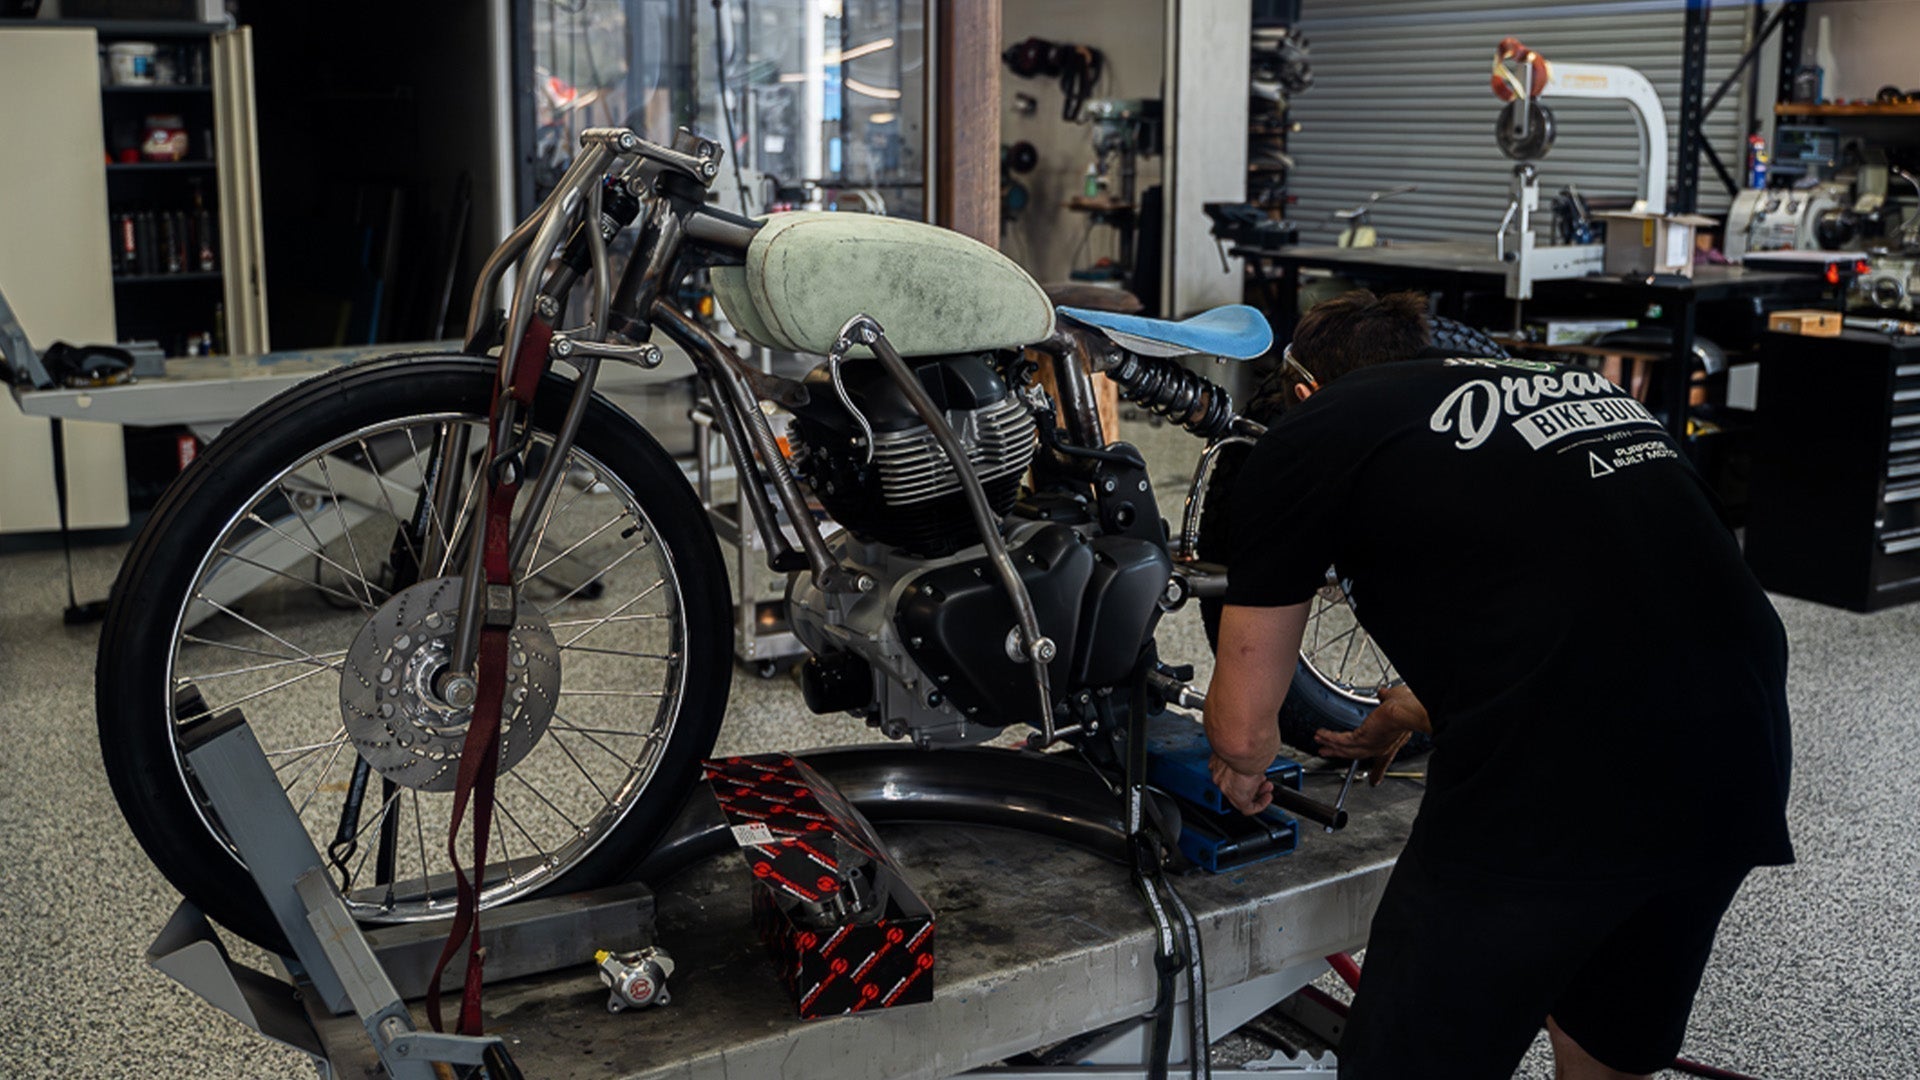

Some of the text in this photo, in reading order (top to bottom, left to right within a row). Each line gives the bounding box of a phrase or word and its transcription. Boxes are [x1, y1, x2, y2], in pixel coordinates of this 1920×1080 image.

[1530, 404, 1596, 438] BIKE
[1603, 429, 1633, 441] WITH
[1612, 453, 1645, 468] BUILT
